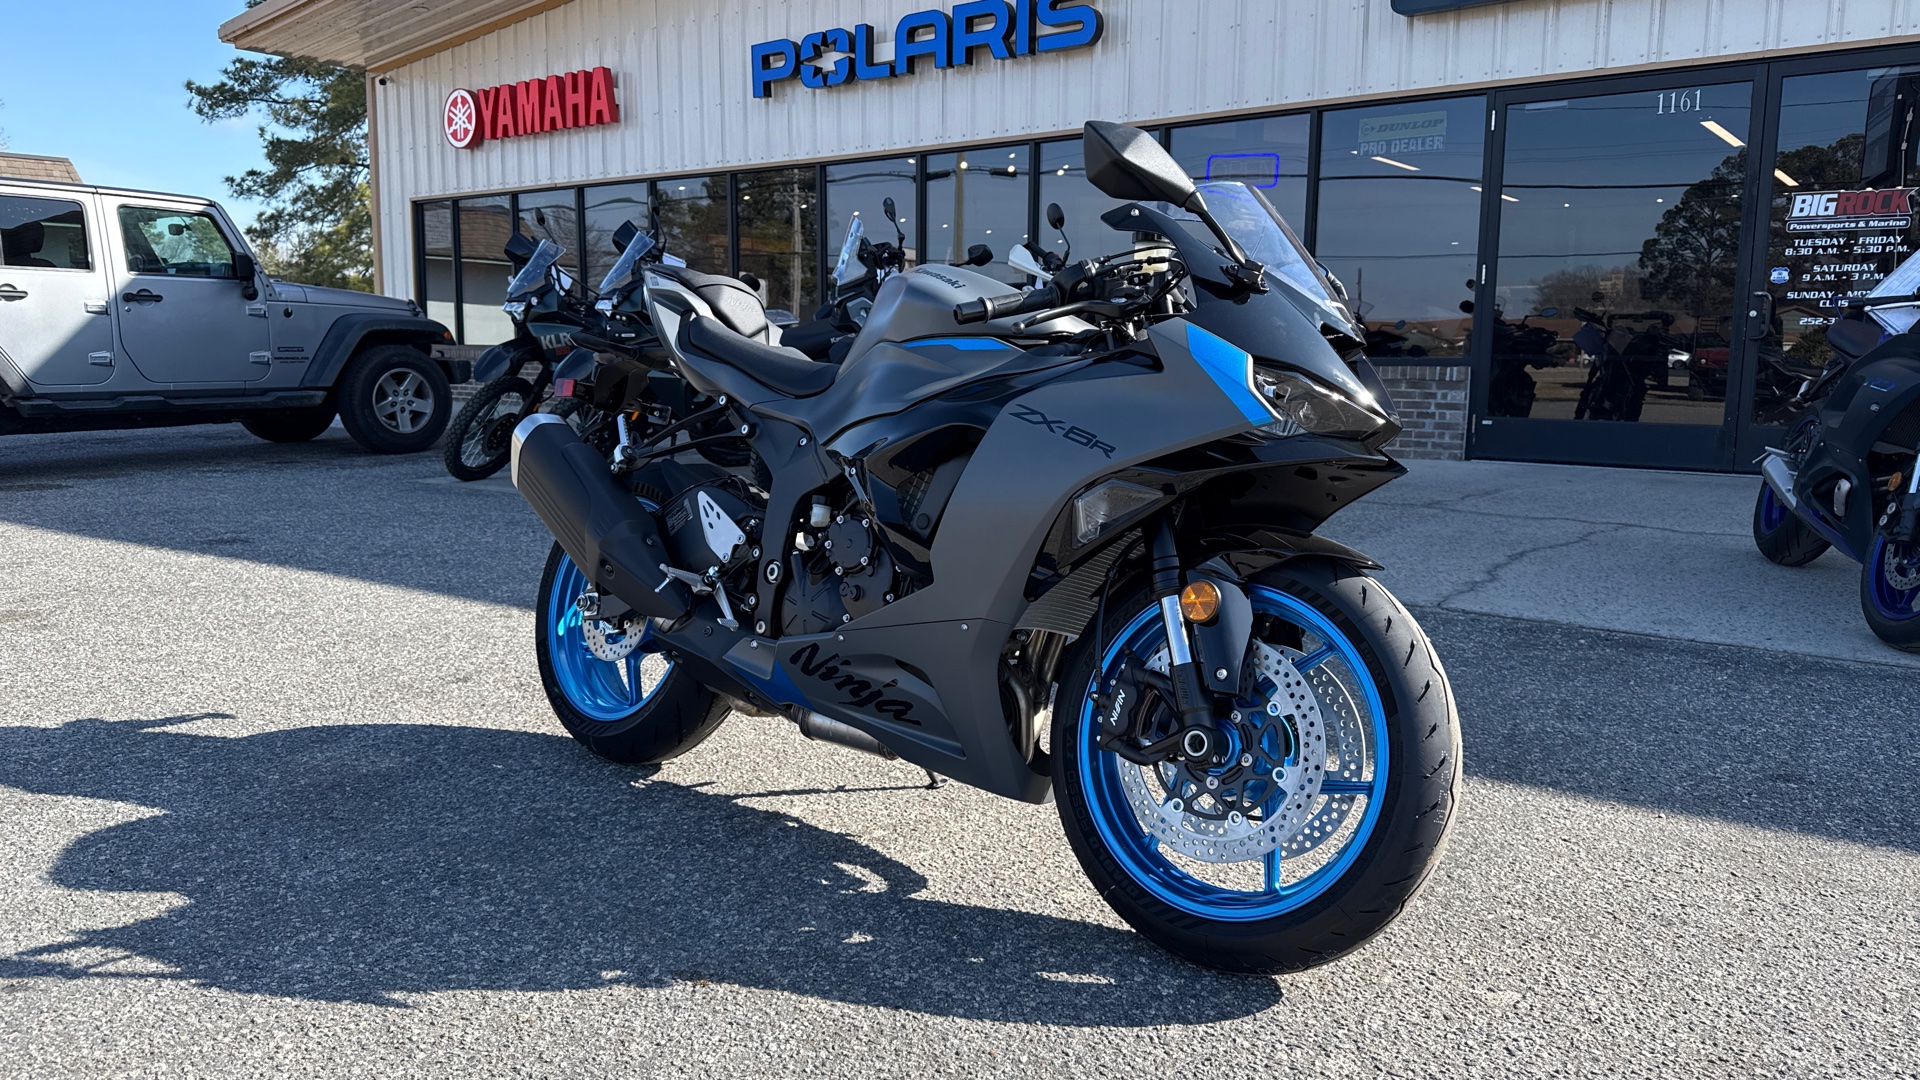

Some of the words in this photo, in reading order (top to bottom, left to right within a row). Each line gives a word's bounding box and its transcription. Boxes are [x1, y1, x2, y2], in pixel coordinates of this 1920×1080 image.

[751, 0, 1101, 99] POLARIS
[477, 66, 616, 140] YAMAHA
[1656, 89, 1701, 114] 1161
[1376, 119, 1444, 132] DUNLOP
[1360, 141, 1386, 156] PRO
[1391, 136, 1443, 154] DEALER
[1789, 221, 1856, 230] Powersports
[1794, 238, 1847, 247] TUESDAY
[1858, 235, 1904, 245] FRIDAY
[1785, 248, 1813, 256] 8:30
[1816, 247, 1840, 255] A.M.
[1853, 245, 1882, 254] 5:30
[1813, 263, 1878, 273] SATURDAY
[1802, 274, 1811, 282] 9
[1813, 273, 1838, 281] A.M.
[1851, 273, 1859, 281] 3
[1862, 272, 1887, 280] P.M.
[1787, 291, 1835, 299] SUNDAY
[1799, 317, 1839, 325] 252-3
[541, 332, 572, 350] KLR
[1008, 403, 1117, 460] ZX-6R
[790, 642, 921, 726] Ninja
[1110, 689, 1125, 726] NISSIN
